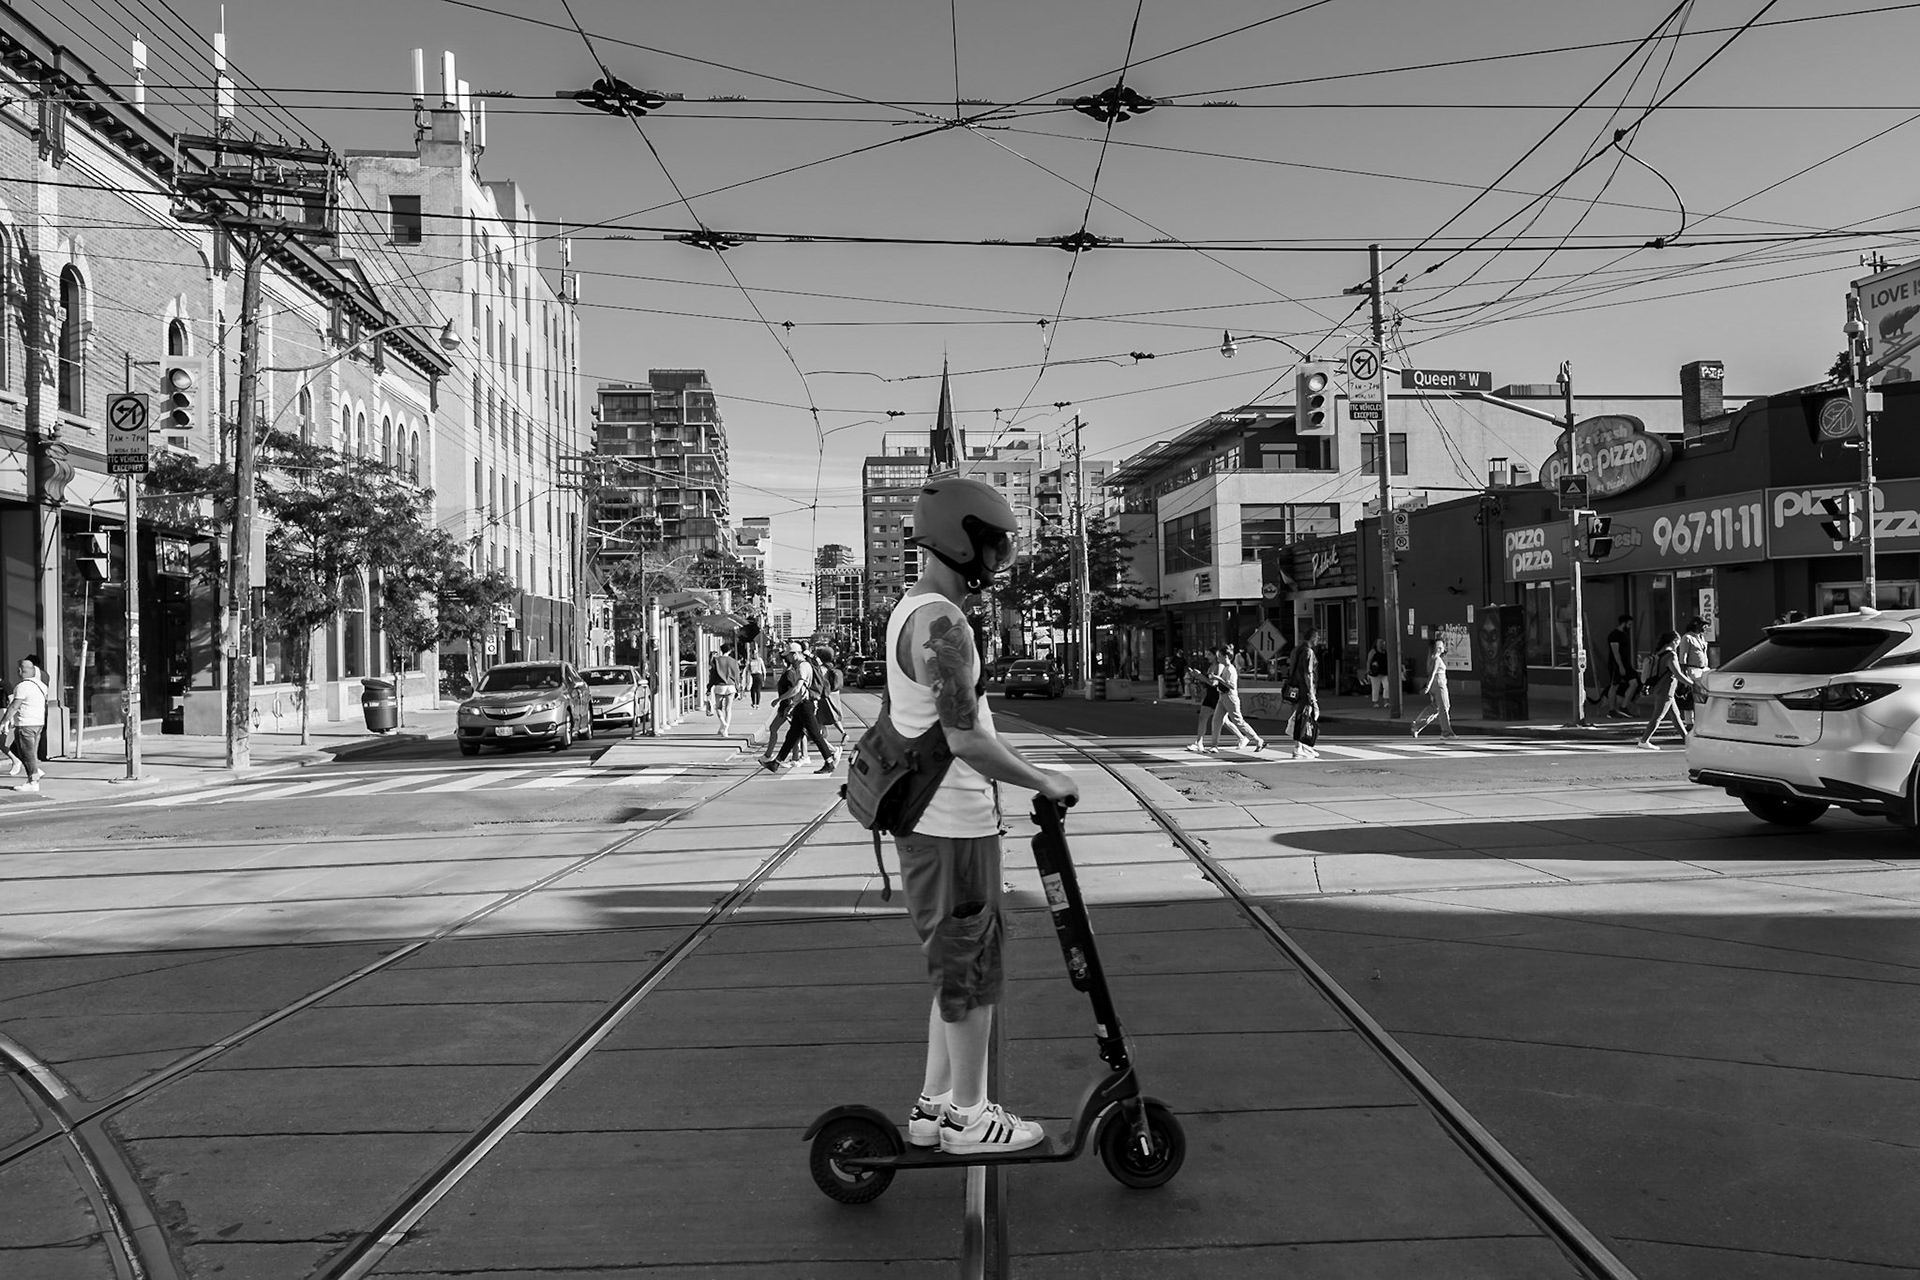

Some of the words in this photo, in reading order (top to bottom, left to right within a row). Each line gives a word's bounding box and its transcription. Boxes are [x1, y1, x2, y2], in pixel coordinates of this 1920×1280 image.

[1871, 282, 1909, 309] LOVE
[1913, 280, 1920, 295] I
[1414, 371, 1456, 386] Queen
[1468, 373, 1480, 386] W
[1360, 403, 1382, 411] VEHICLES
[109, 434, 123, 442] 7AM
[132, 434, 145, 442] 7PM
[108, 455, 118, 463] TTC
[120, 455, 148, 463] VEHICLES
[1597, 440, 1647, 477] pizza
[1505, 528, 1545, 558] pizza
[1512, 549, 1553, 579] pizza
